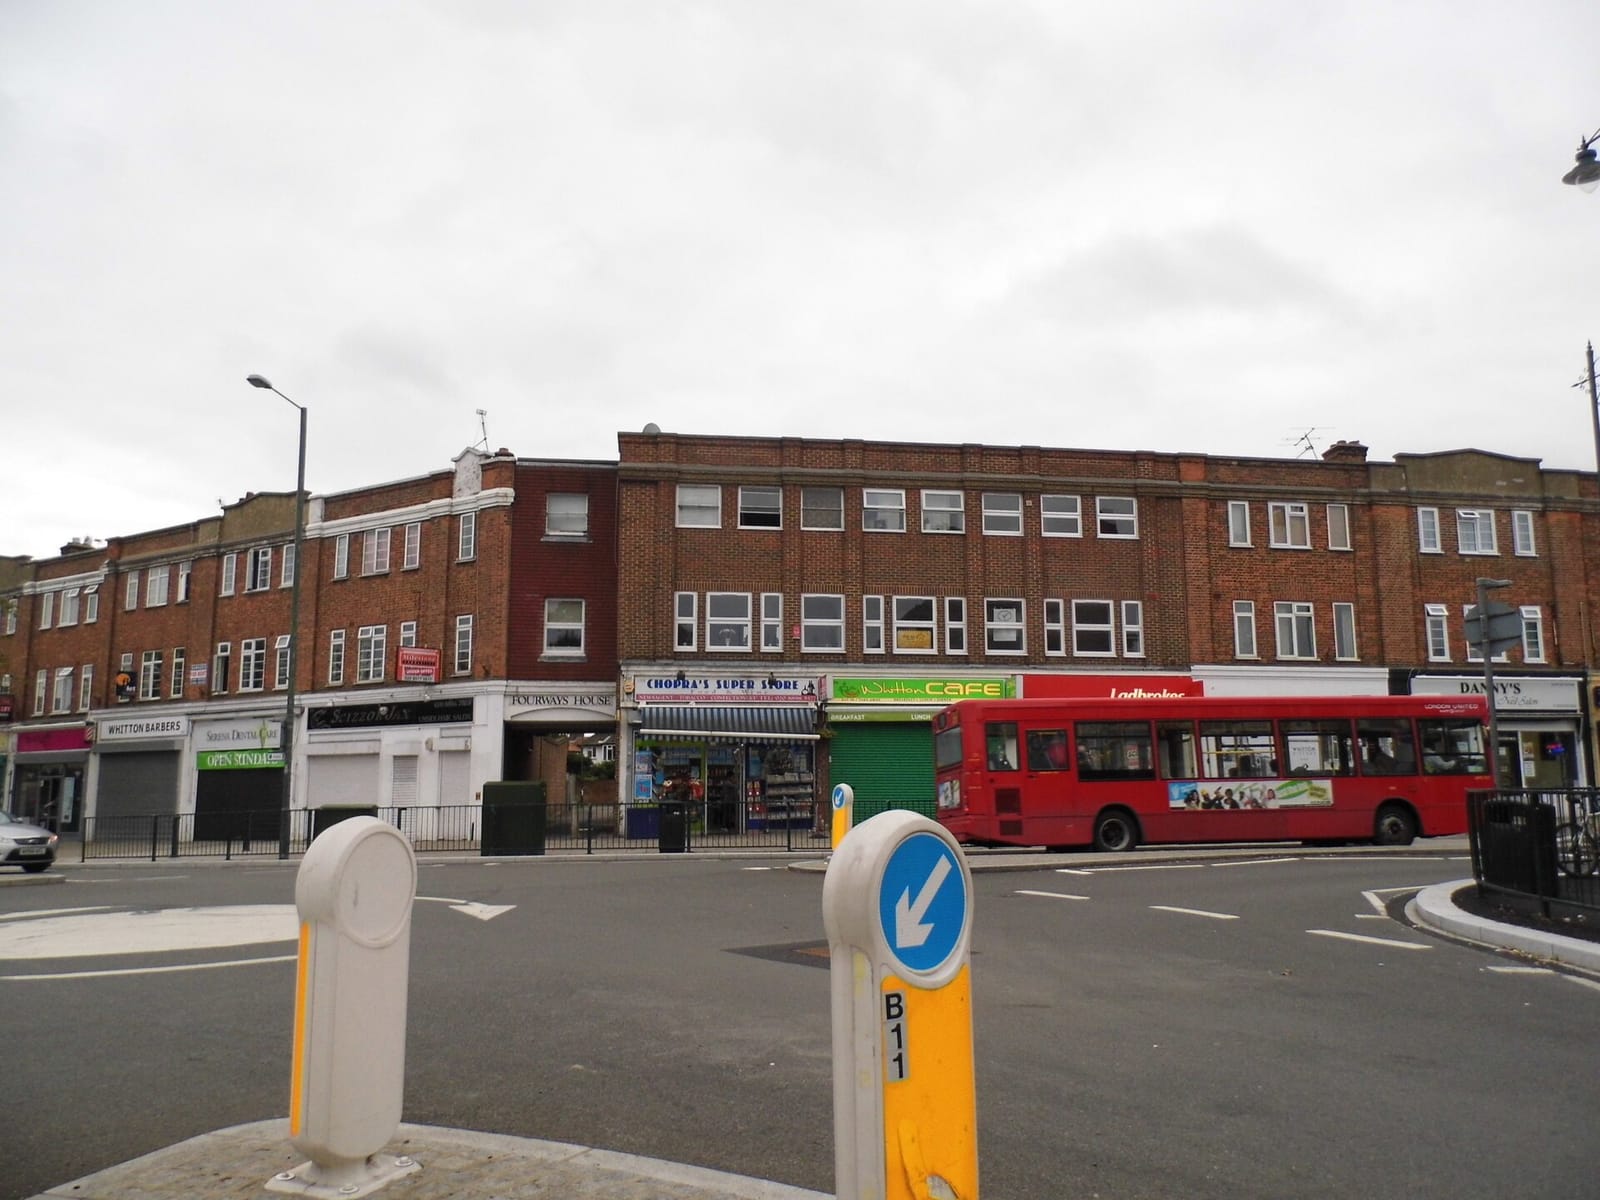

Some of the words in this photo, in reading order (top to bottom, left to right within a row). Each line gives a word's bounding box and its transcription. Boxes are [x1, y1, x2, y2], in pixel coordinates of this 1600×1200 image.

[647, 679, 709, 689] CHOPRA'S
[716, 679, 755, 689] SUPER
[512, 695, 569, 705] FOURWAYS
[574, 695, 610, 705] HOUSE
[109, 723, 144, 735] WHITTON
[145, 721, 181, 732] BARBERS
[207, 753, 232, 767] OPEN
